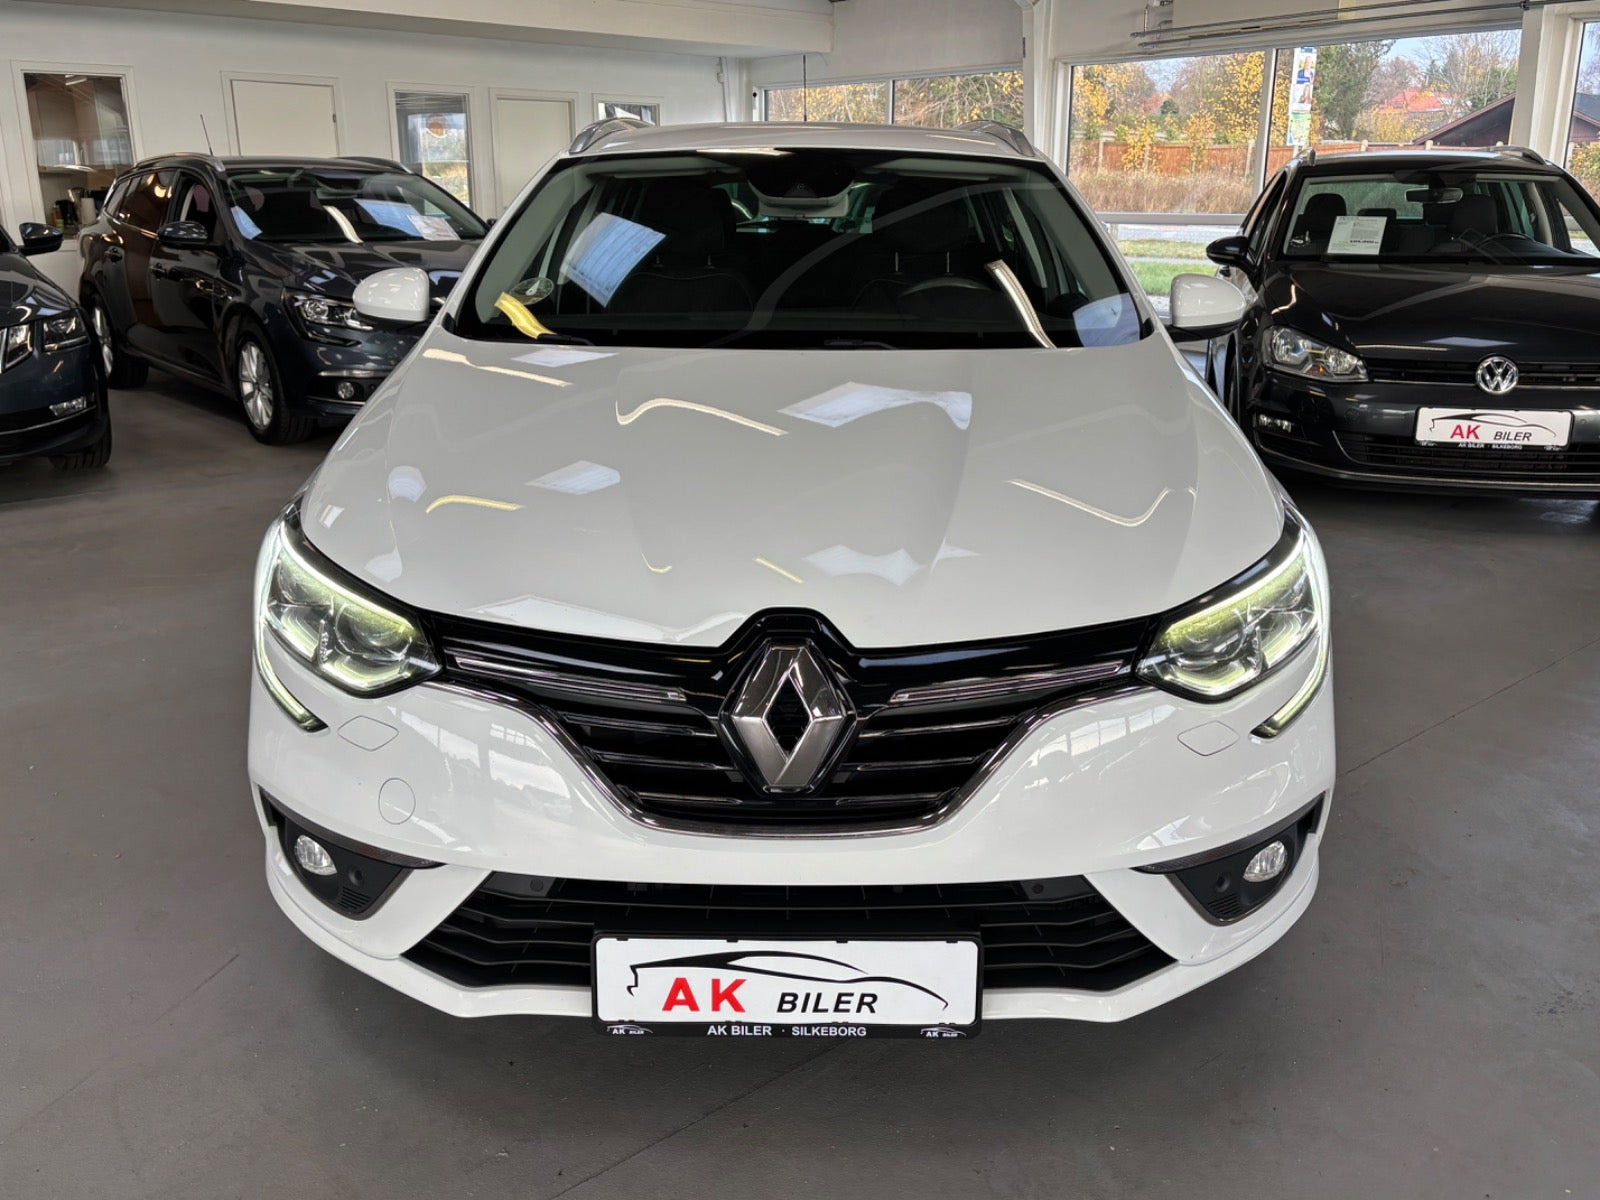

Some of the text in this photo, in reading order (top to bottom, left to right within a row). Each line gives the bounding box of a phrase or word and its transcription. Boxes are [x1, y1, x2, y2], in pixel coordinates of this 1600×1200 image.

[1450, 424, 1533, 442] AK BILER
[661, 977, 879, 1014] AK BILER
[707, 1025, 867, 1037] AK BILER SILKEBORG
